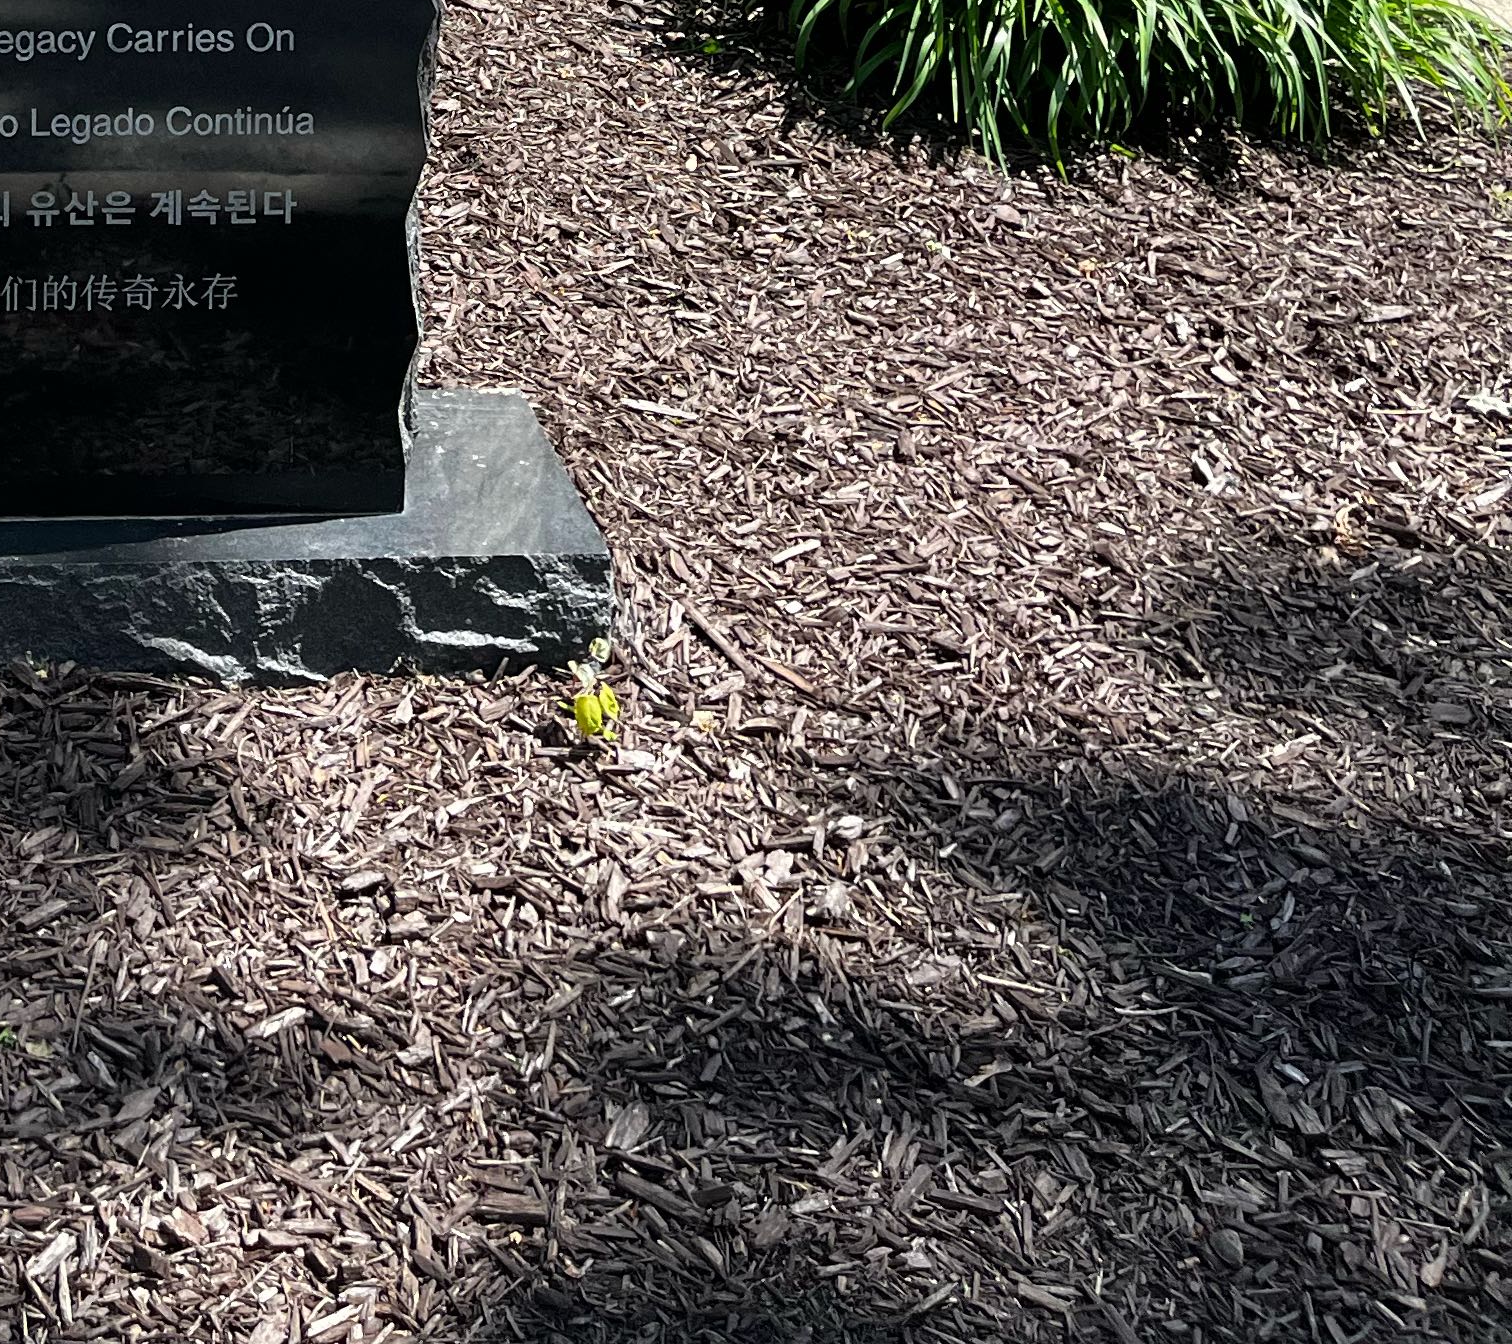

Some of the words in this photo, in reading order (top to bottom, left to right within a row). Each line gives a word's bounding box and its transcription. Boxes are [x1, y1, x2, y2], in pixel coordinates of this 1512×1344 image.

[106, 23, 235, 54] Carries
[246, 22, 295, 52] On
[30, 108, 155, 144] Legado
[165, 106, 315, 137] Continúa
[26, 190, 137, 226] 유산은
[149, 189, 298, 226] 계속된다
